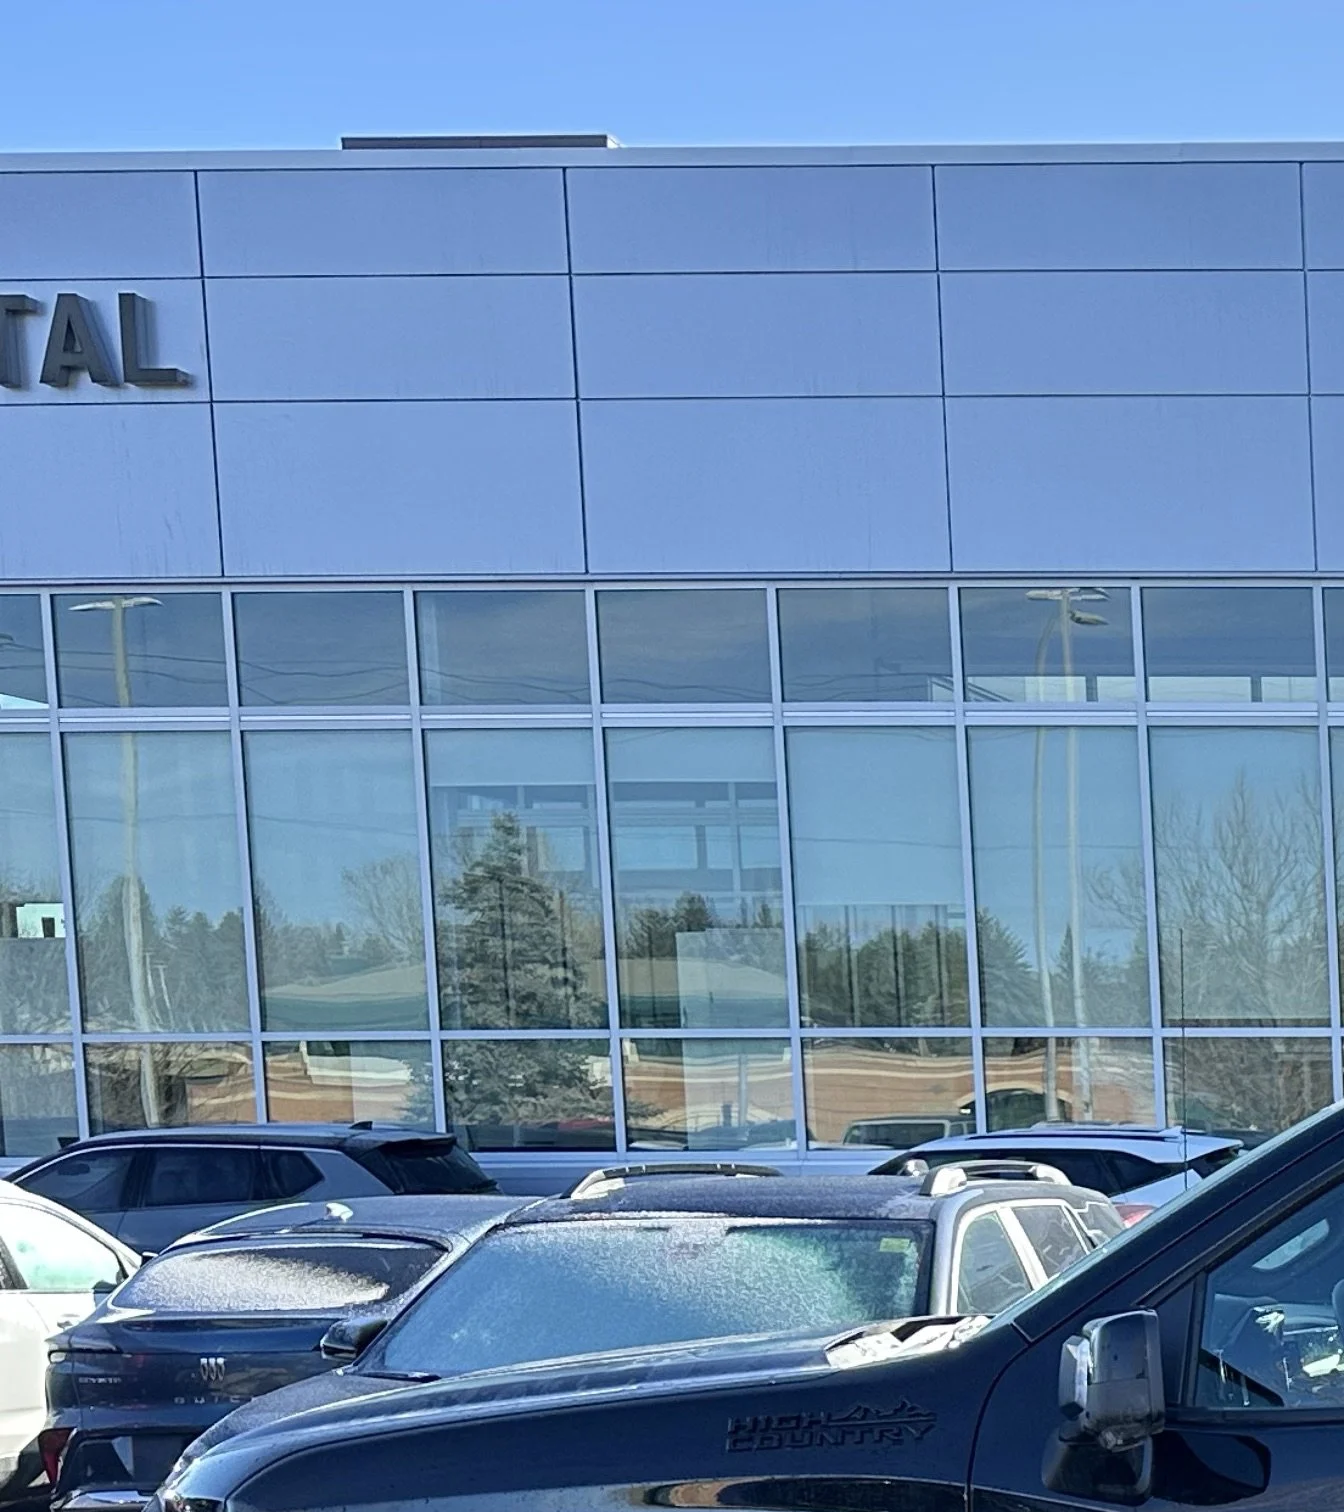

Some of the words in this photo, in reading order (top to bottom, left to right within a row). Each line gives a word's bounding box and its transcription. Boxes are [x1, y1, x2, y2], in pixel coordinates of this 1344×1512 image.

[173, 1395, 243, 1405] BUIC
[727, 1411, 832, 1433] HIGH
[726, 1424, 936, 1453] COUNTRY
